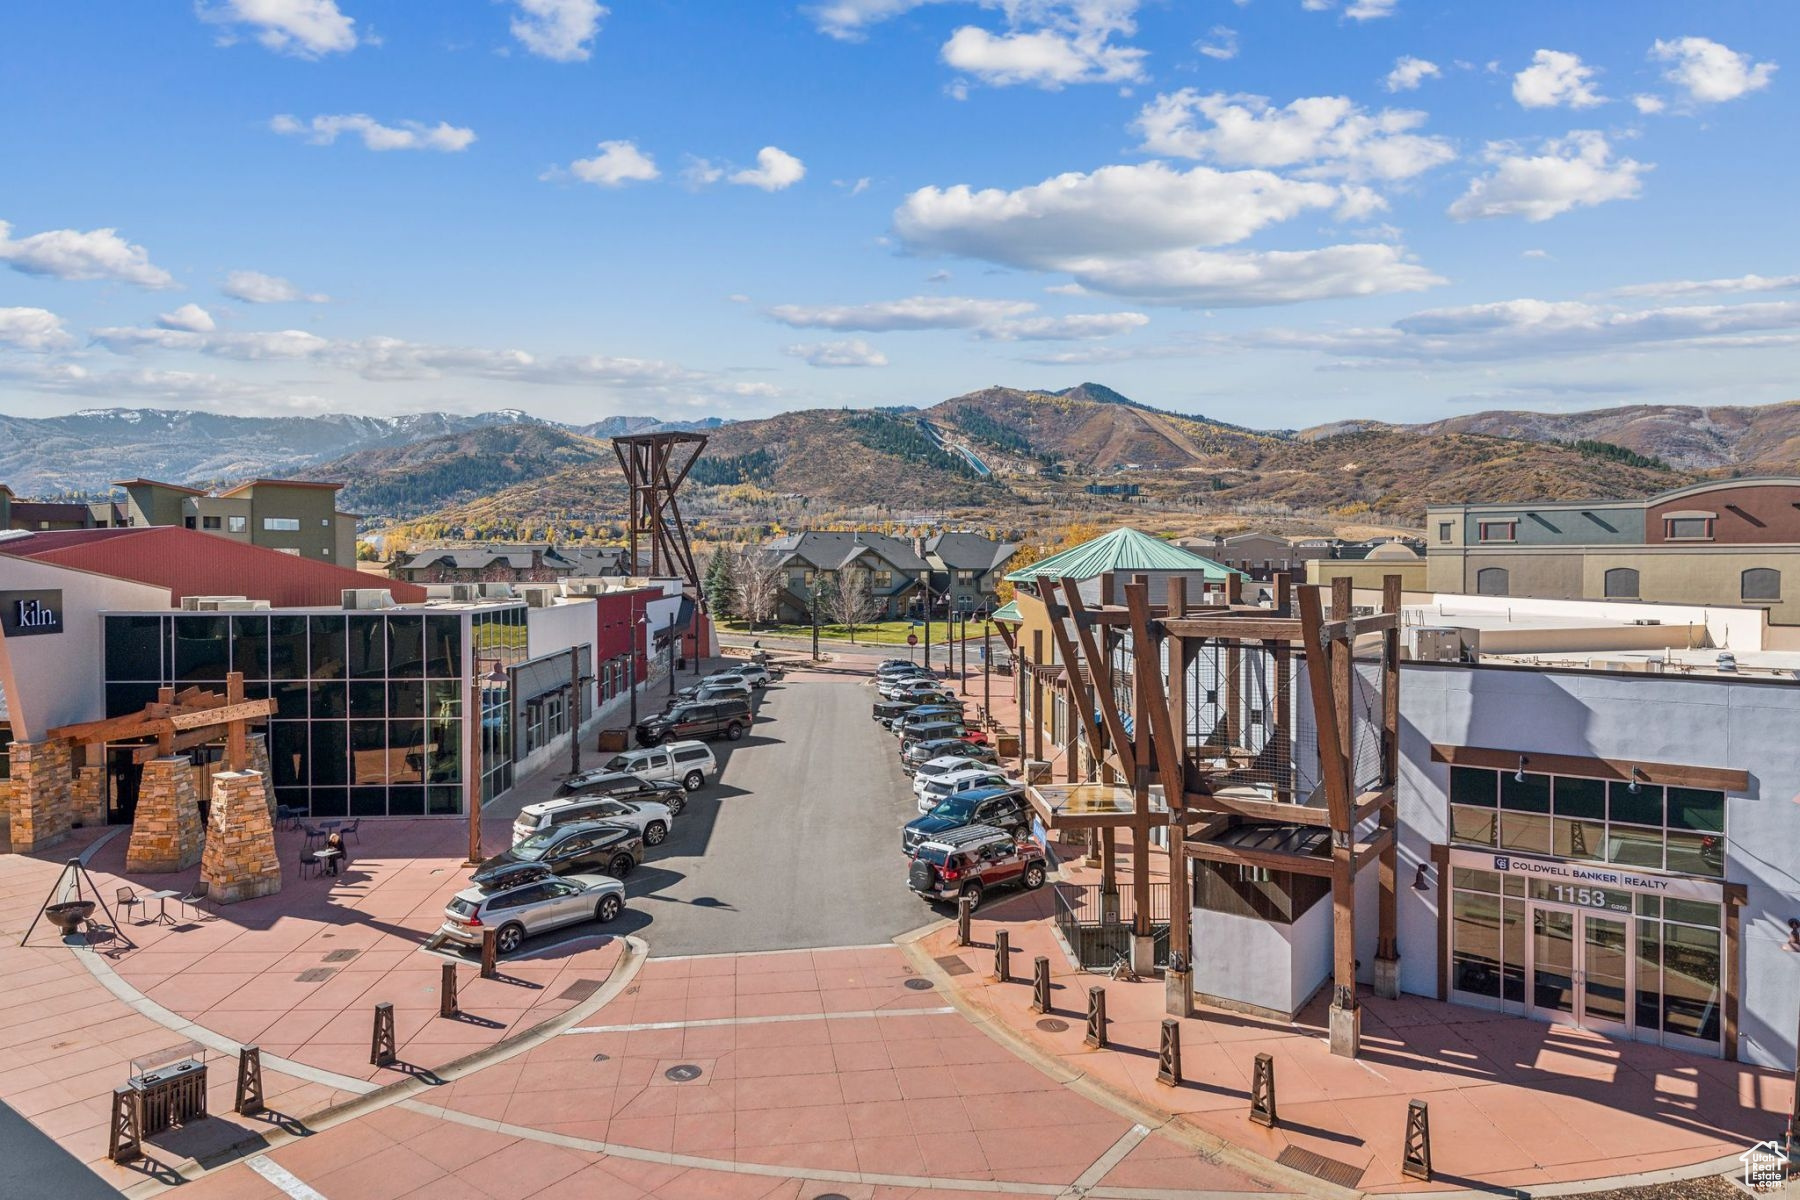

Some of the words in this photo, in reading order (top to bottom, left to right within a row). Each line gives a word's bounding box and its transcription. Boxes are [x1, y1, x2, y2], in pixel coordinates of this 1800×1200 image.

[20, 600, 56, 627] kiln.
[1512, 862, 1570, 877] COLDWELL
[1572, 870, 1617, 883] BANKER
[1624, 877, 1669, 890] REALTY
[1554, 885, 1605, 907] 1153
